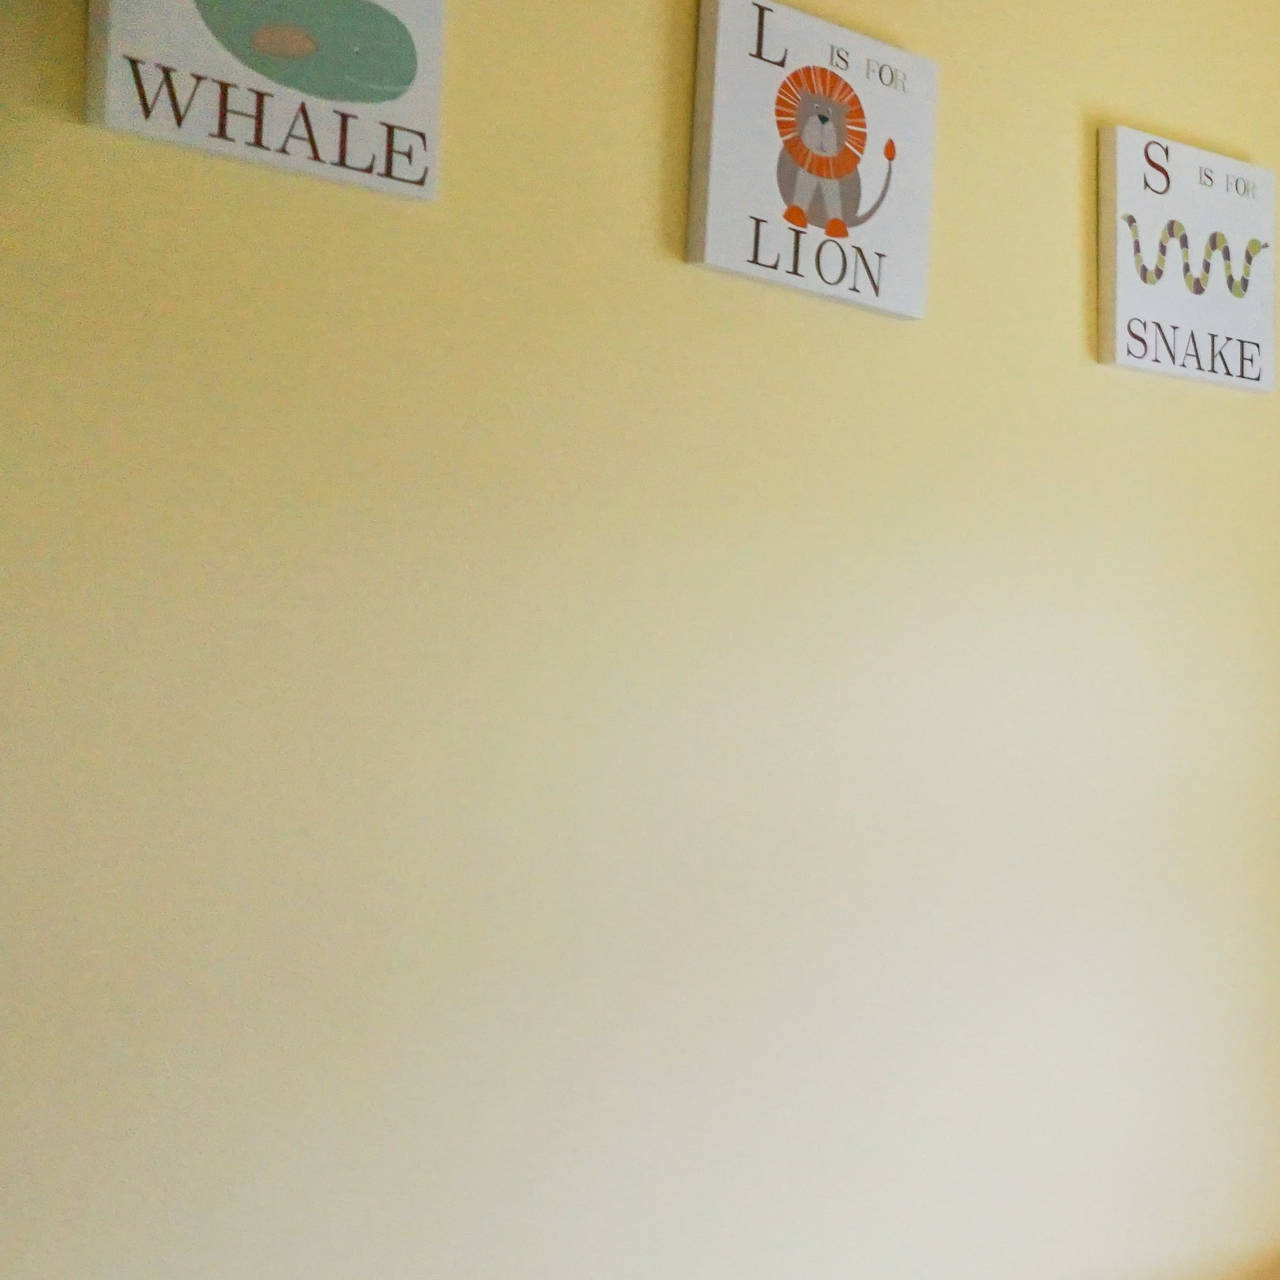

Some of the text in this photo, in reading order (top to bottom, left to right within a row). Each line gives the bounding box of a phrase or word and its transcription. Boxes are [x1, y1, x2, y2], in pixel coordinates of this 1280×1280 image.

[748, 2, 909, 93] L IS FOR
[123, 55, 428, 186] WHALE
[1143, 141, 1170, 195] S
[1198, 166, 1214, 188] IS
[747, 215, 887, 298] LION
[1126, 317, 1262, 382] SNAKE
